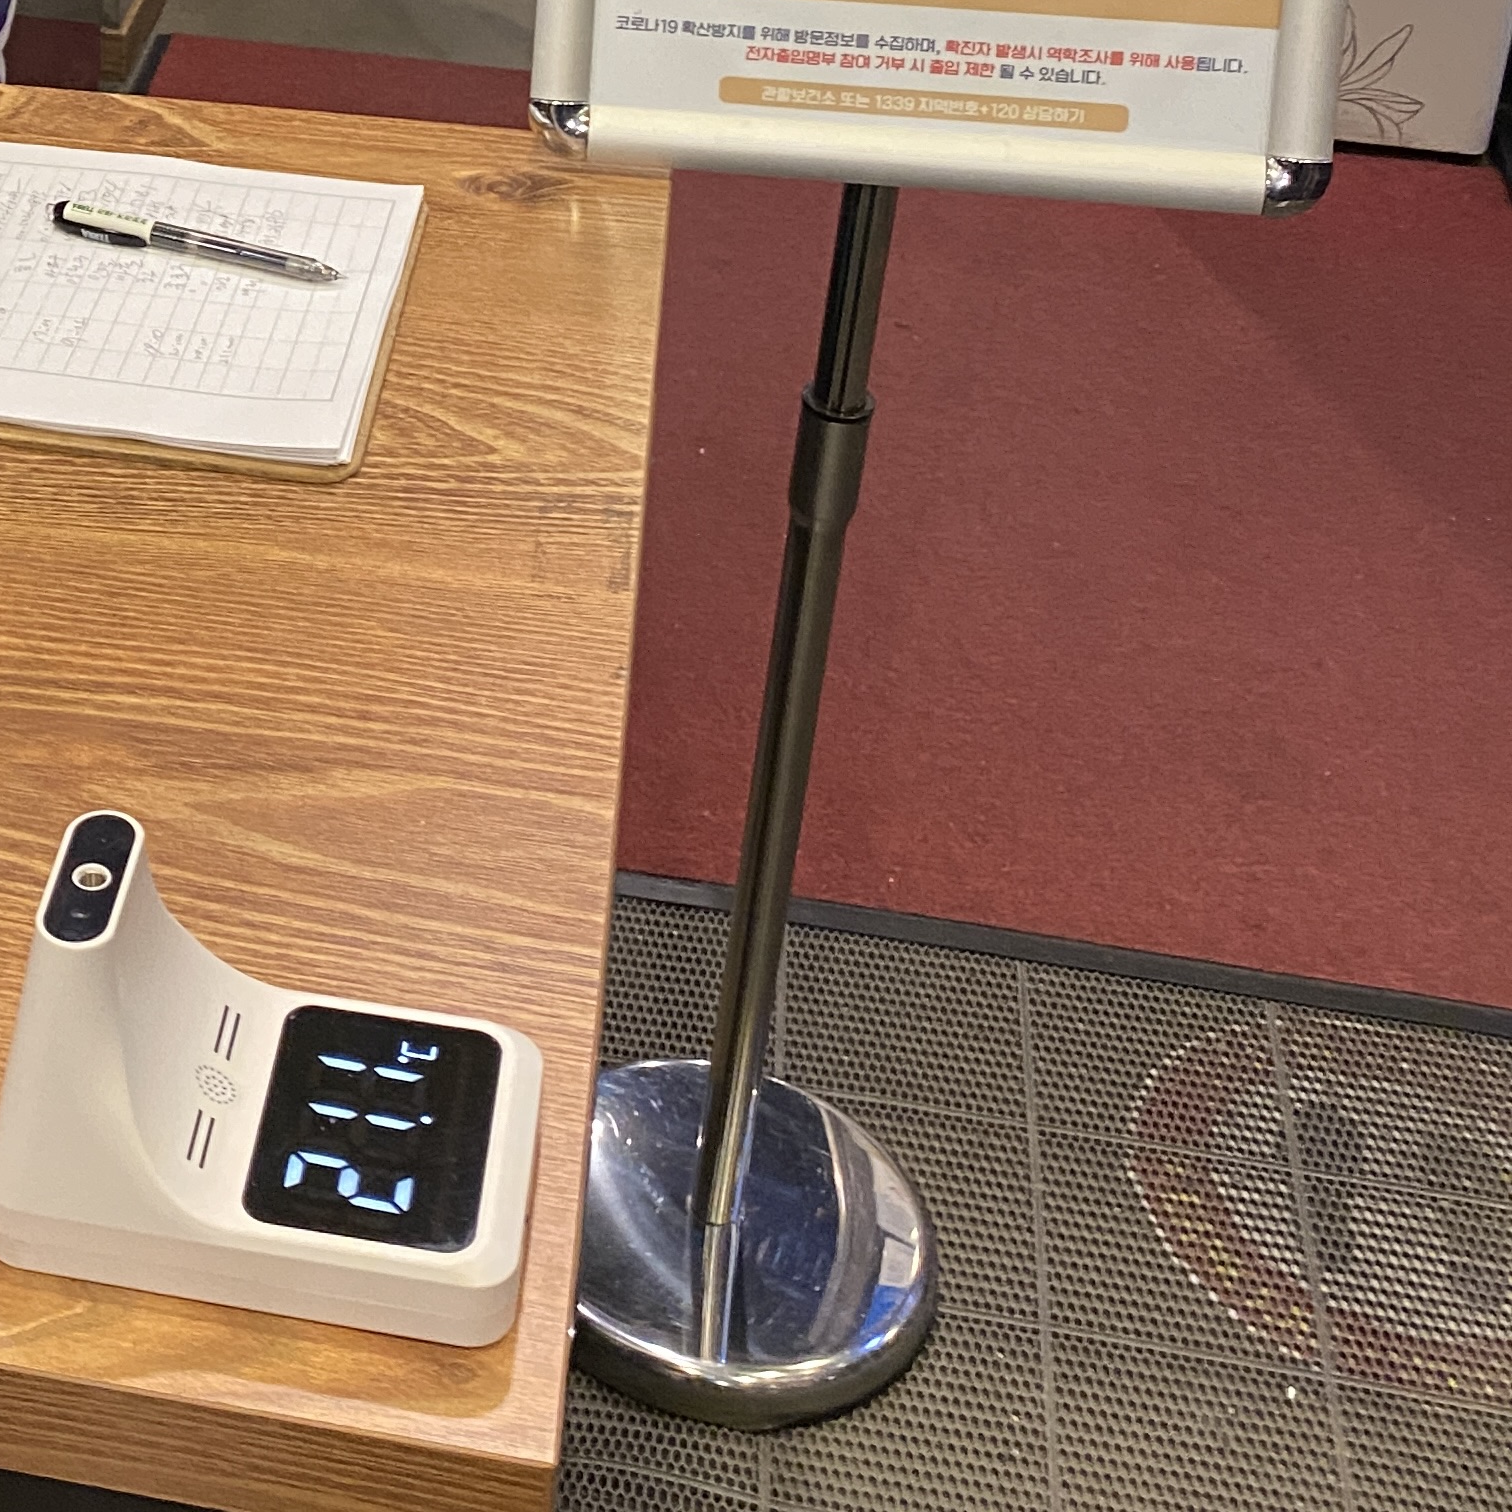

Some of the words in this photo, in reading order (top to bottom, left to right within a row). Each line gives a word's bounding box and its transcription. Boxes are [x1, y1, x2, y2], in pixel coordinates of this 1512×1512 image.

[616, 15, 678, 34] 코로나19
[682, 20, 756, 41] 확산방지를
[760, 25, 790, 43] 위해
[794, 28, 869, 49] 방문정보를
[874, 34, 941, 55] 수집하며,
[945, 39, 991, 57] 확진자
[995, 42, 1042, 61] 발생시
[1046, 46, 1125, 67] 역학조사를
[1129, 51, 1160, 68] 위해
[1164, 55, 1249, 75] 사용됩니다.
[746, 44, 836, 67] 전자출입명부
[839, 52, 871, 70] 참여
[875, 56, 905, 72] 거부
[909, 58, 925, 74] 시
[929, 57, 960, 76] 출입
[963, 60, 995, 79] 제한
[1019, 65, 1035, 81] 수
[1038, 67, 1107, 86] 있습니다.
[761, 85, 837, 106] 관할보건소
[840, 91, 870, 109] 또는
[875, 94, 914, 111] 1339
[918, 97, 1019, 120] 지역번호+120
[1022, 102, 1085, 124] 상담하기
